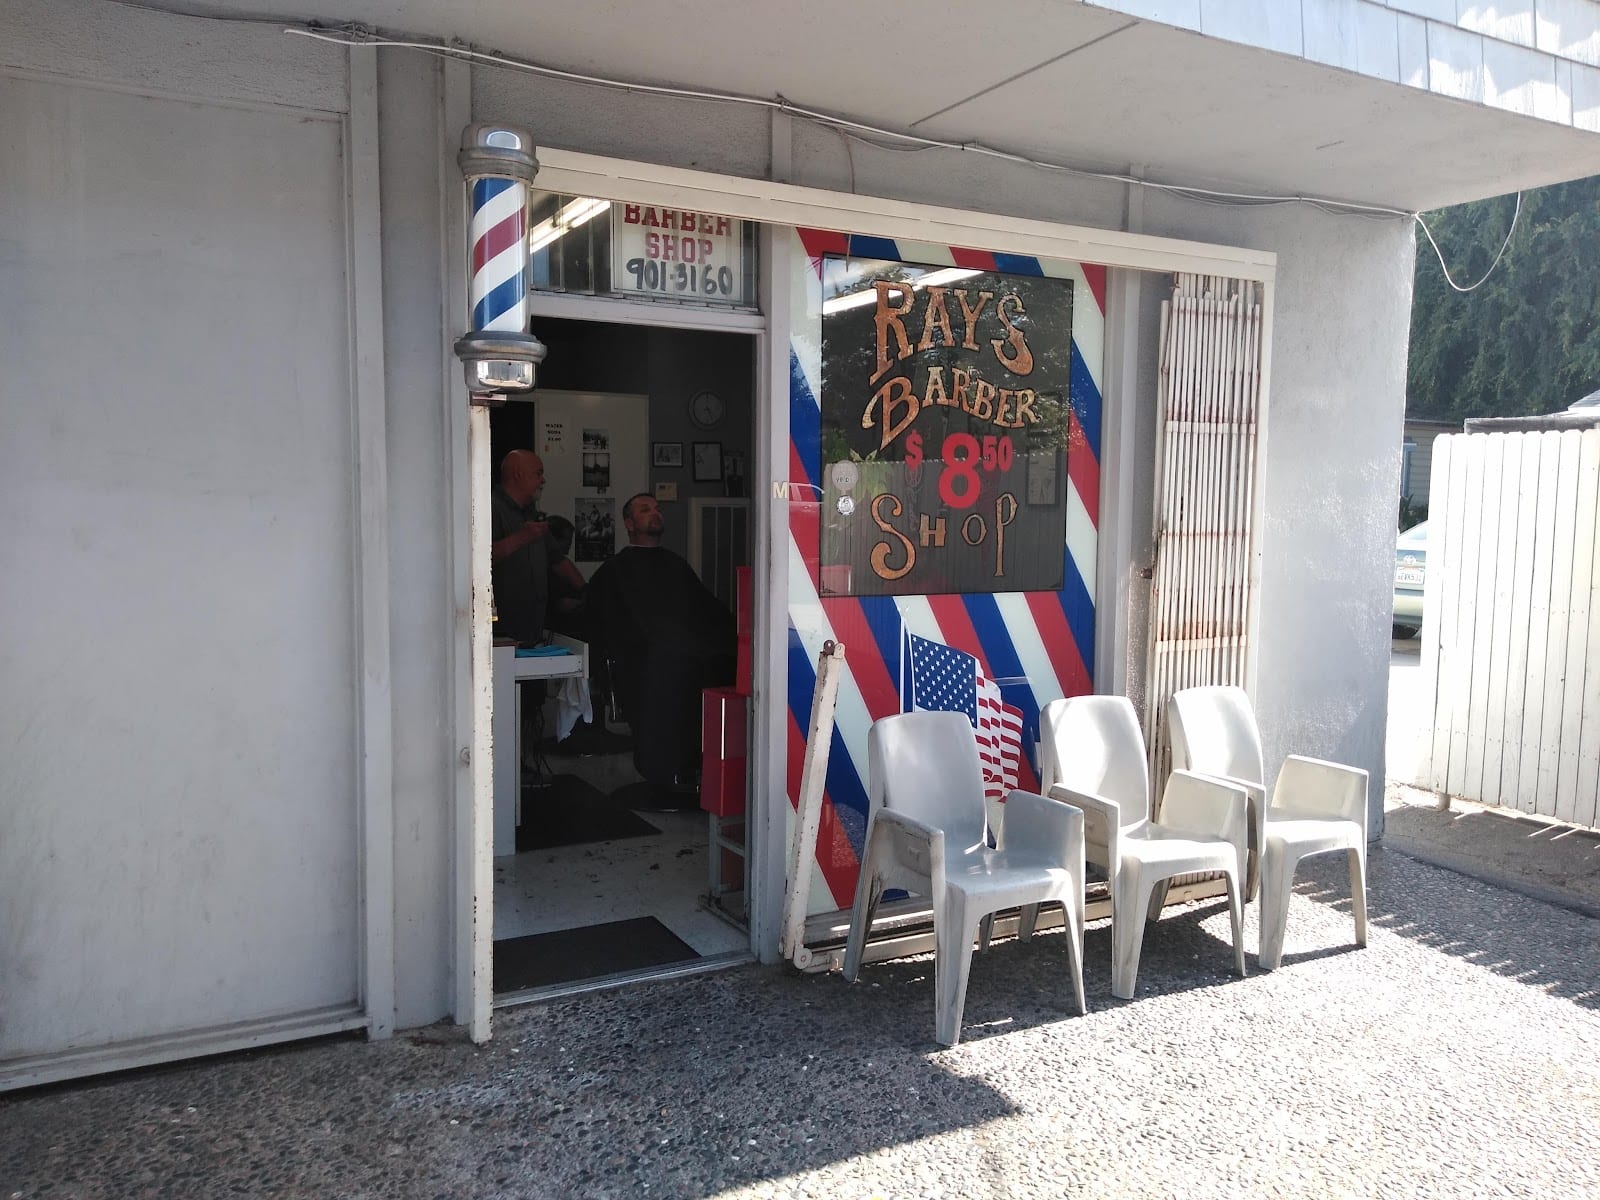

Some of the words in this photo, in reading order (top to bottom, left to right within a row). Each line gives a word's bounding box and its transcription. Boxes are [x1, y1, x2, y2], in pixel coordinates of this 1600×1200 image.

[624, 203, 732, 237] BARBER
[645, 232, 713, 265] SHOP
[861, 366, 1042, 450] BARBER
[869, 492, 1019, 581] SHOP
